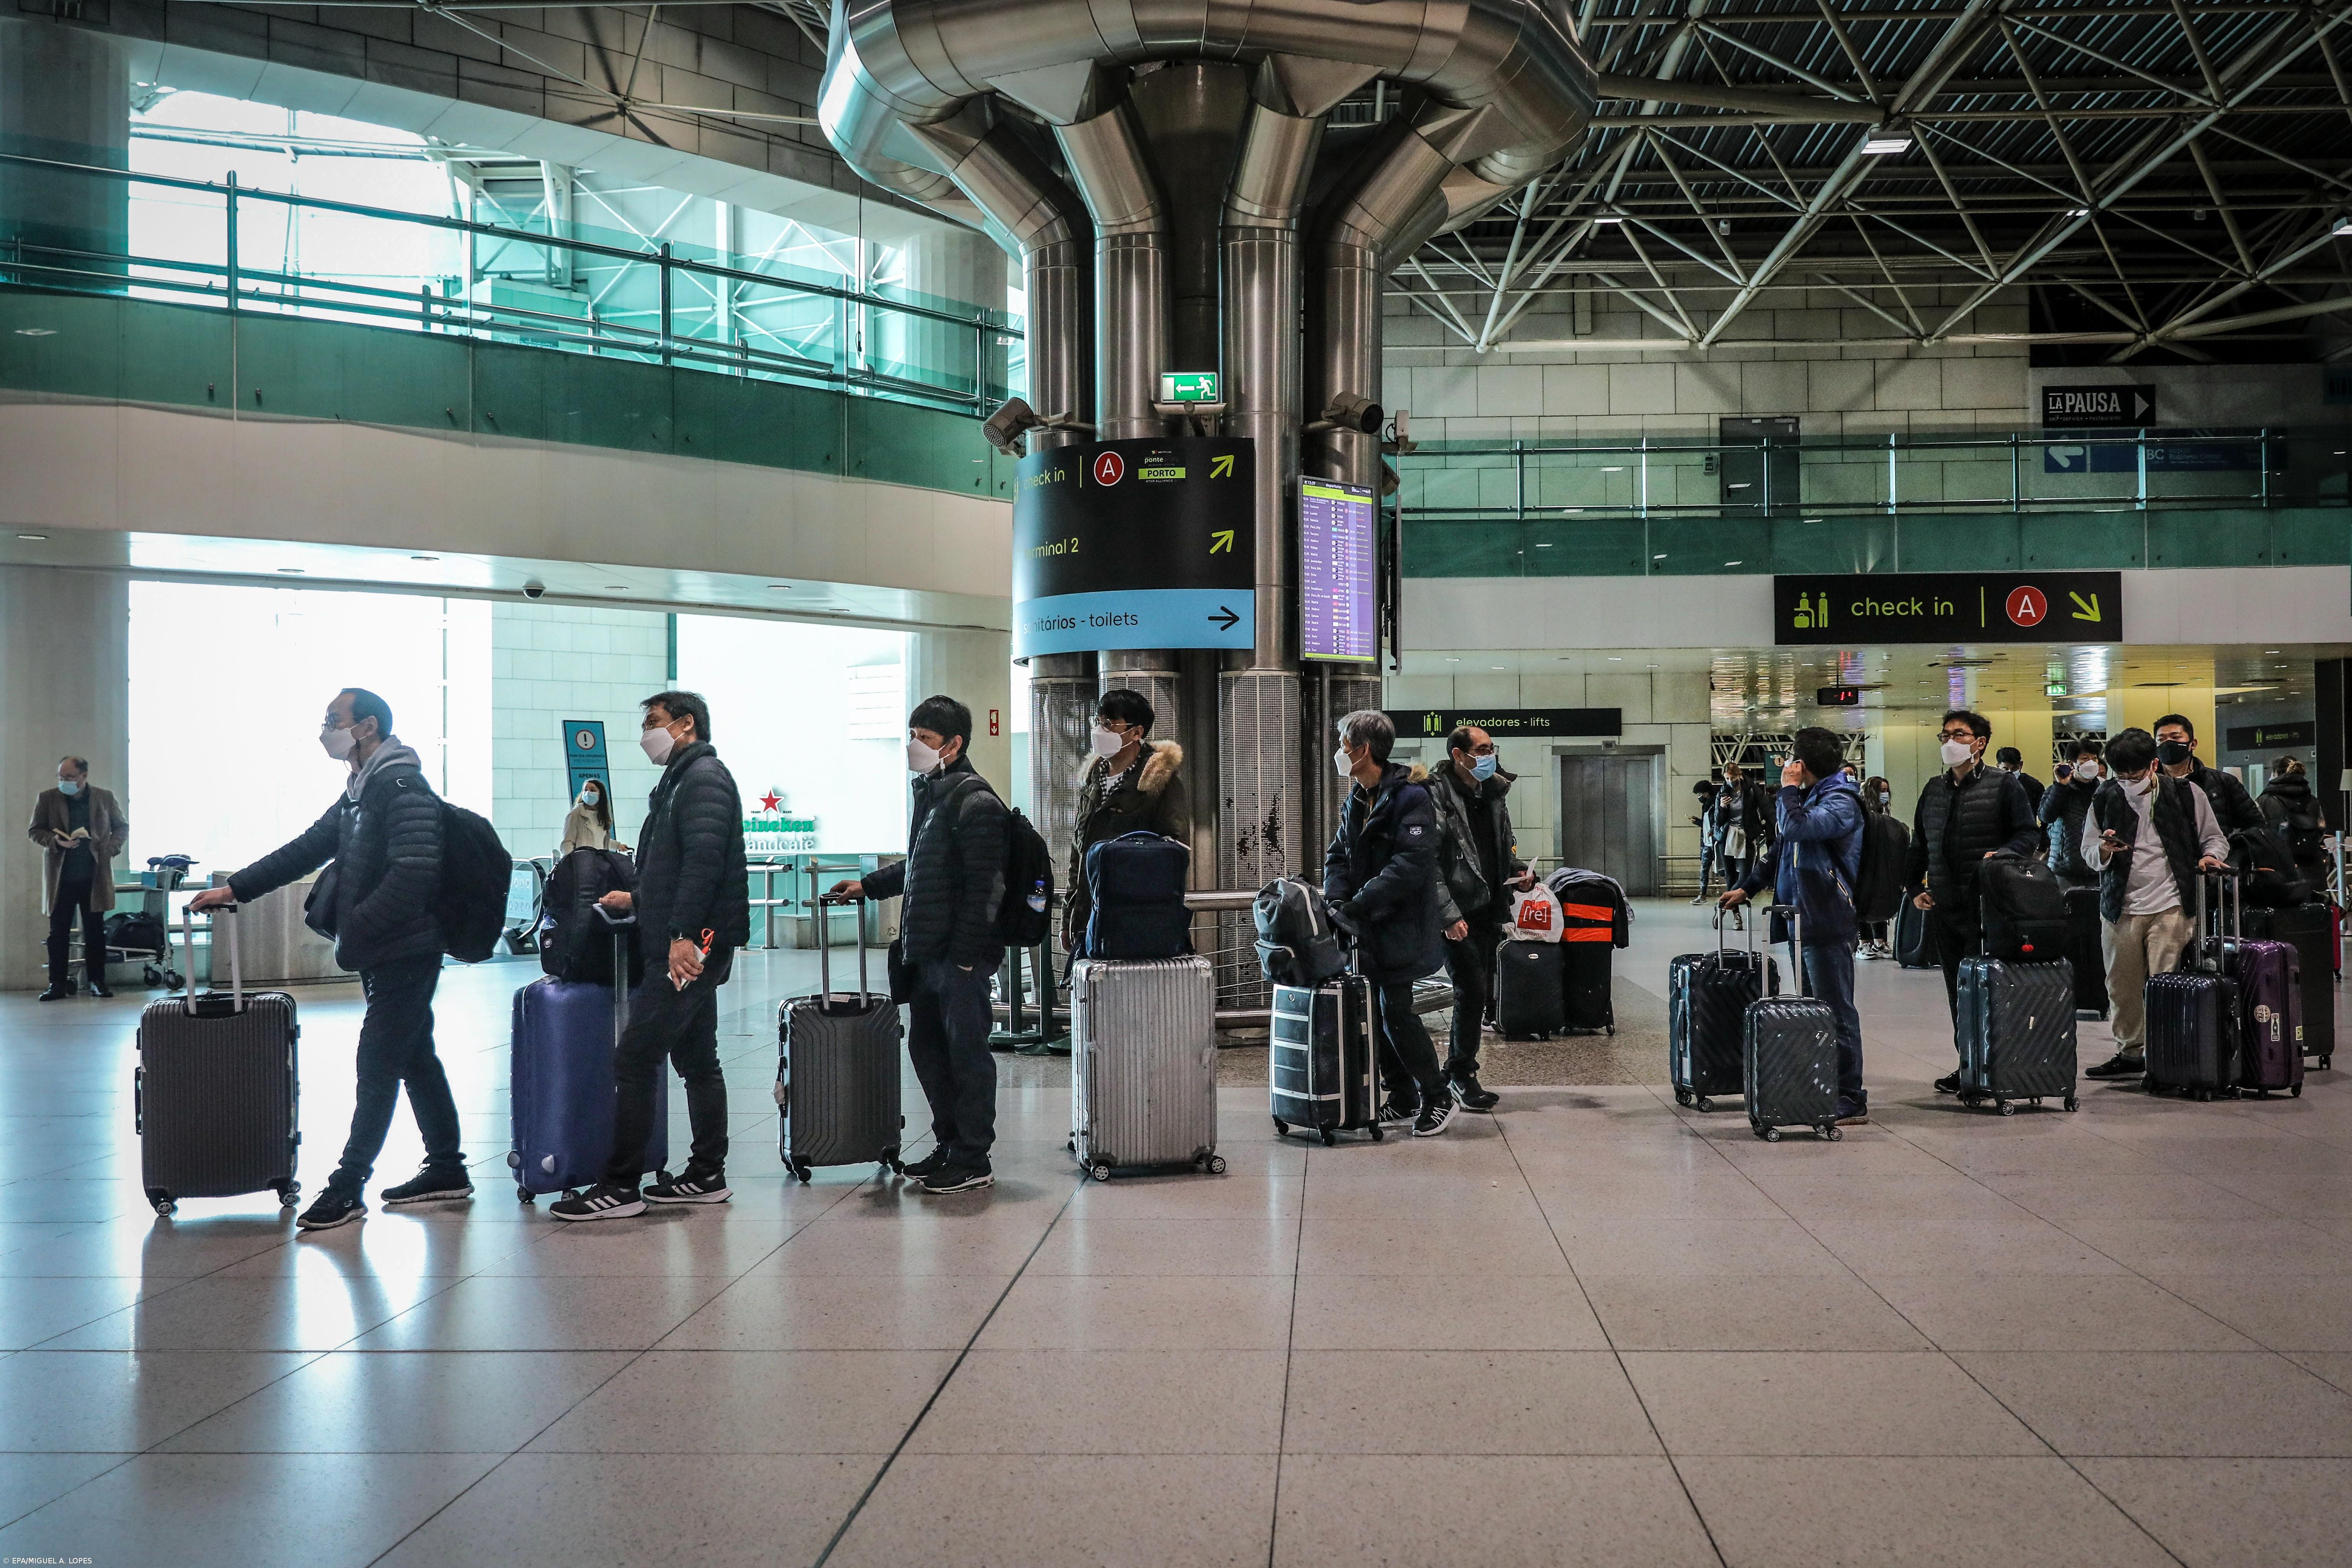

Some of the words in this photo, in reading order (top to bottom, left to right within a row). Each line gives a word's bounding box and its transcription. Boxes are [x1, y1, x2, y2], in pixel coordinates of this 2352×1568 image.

[2049, 397, 2063, 409] LA
[2065, 393, 2121, 412] PAUSA
[1024, 469, 1051, 490] check
[1054, 467, 1065, 482] in
[1102, 458, 1116, 477] A
[1071, 537, 1078, 553] 2
[1851, 597, 1923, 616] check
[1934, 596, 1954, 615] in
[2017, 595, 2036, 617] A
[1089, 612, 1138, 627] toilets
[1456, 717, 1520, 727] elevadores
[1530, 717, 1550, 726] lifts
[743, 817, 814, 832] eineken
